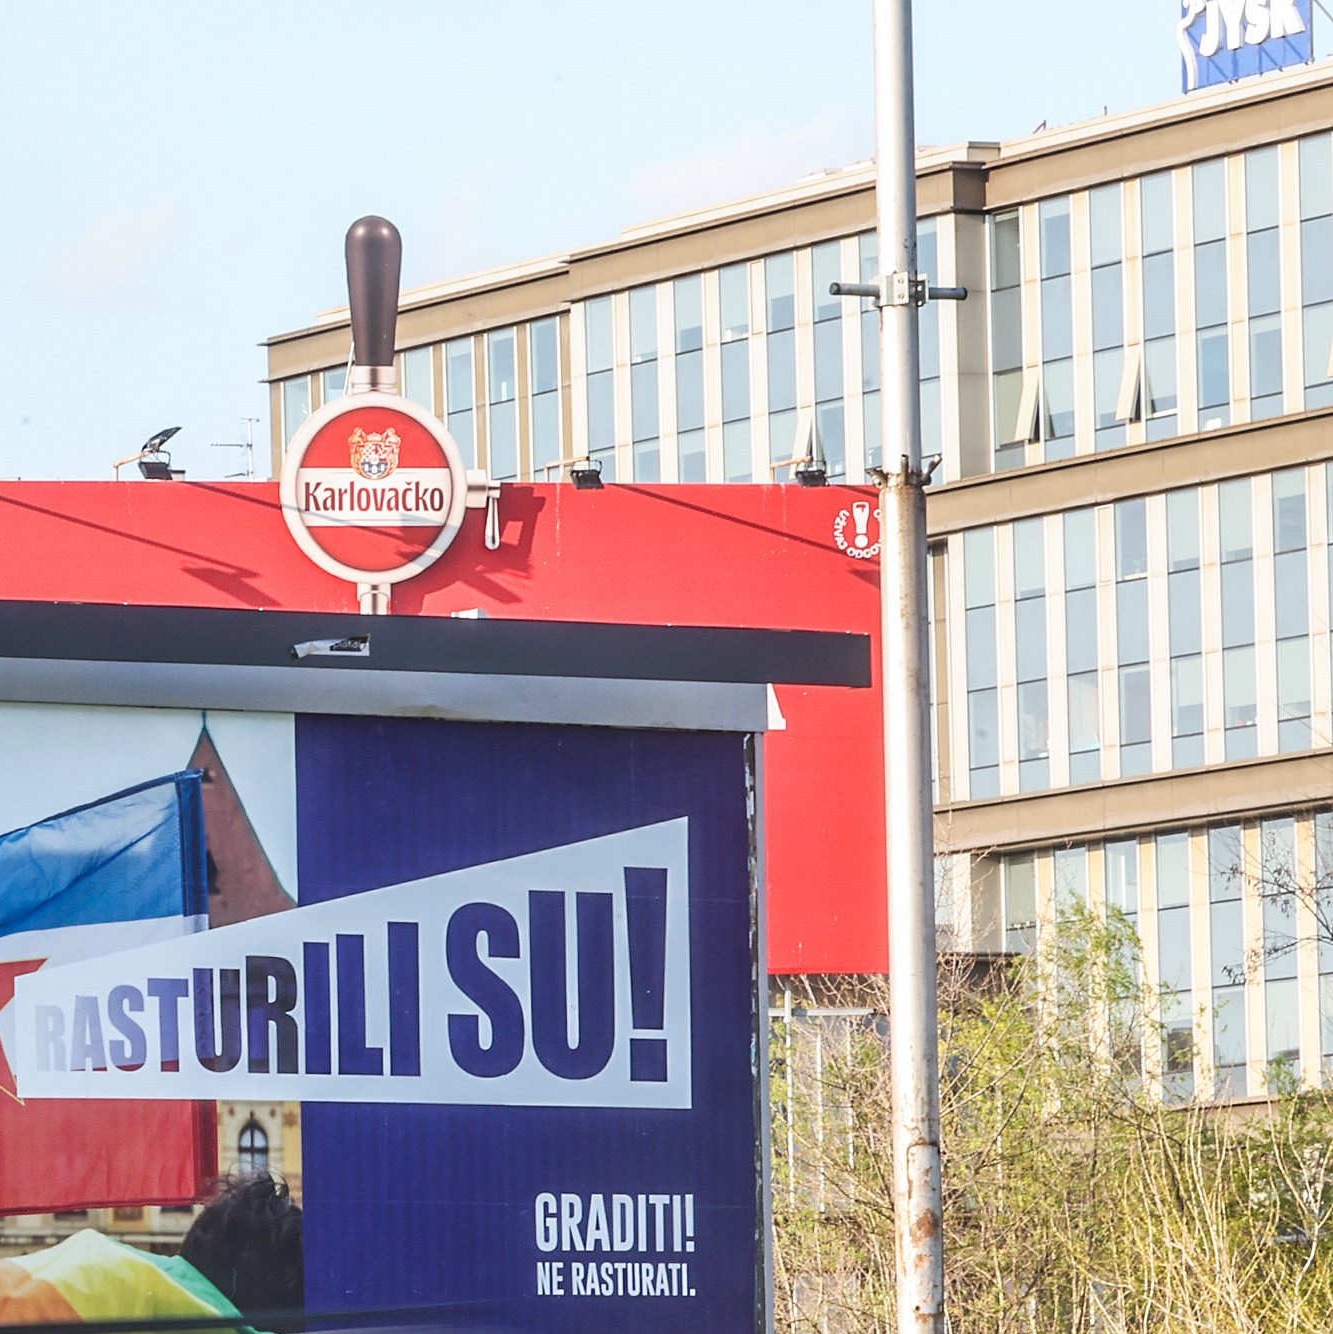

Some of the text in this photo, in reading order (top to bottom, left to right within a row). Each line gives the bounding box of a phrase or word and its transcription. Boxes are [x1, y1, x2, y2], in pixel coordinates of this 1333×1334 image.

[1199, 0, 1306, 57] JYSK
[304, 480, 444, 512] Karlovačko
[34, 866, 668, 1083] RASTURILI SU!
[535, 1192, 695, 1252] GRADITI!
[537, 1262, 696, 1297] NE RASTURATI.
